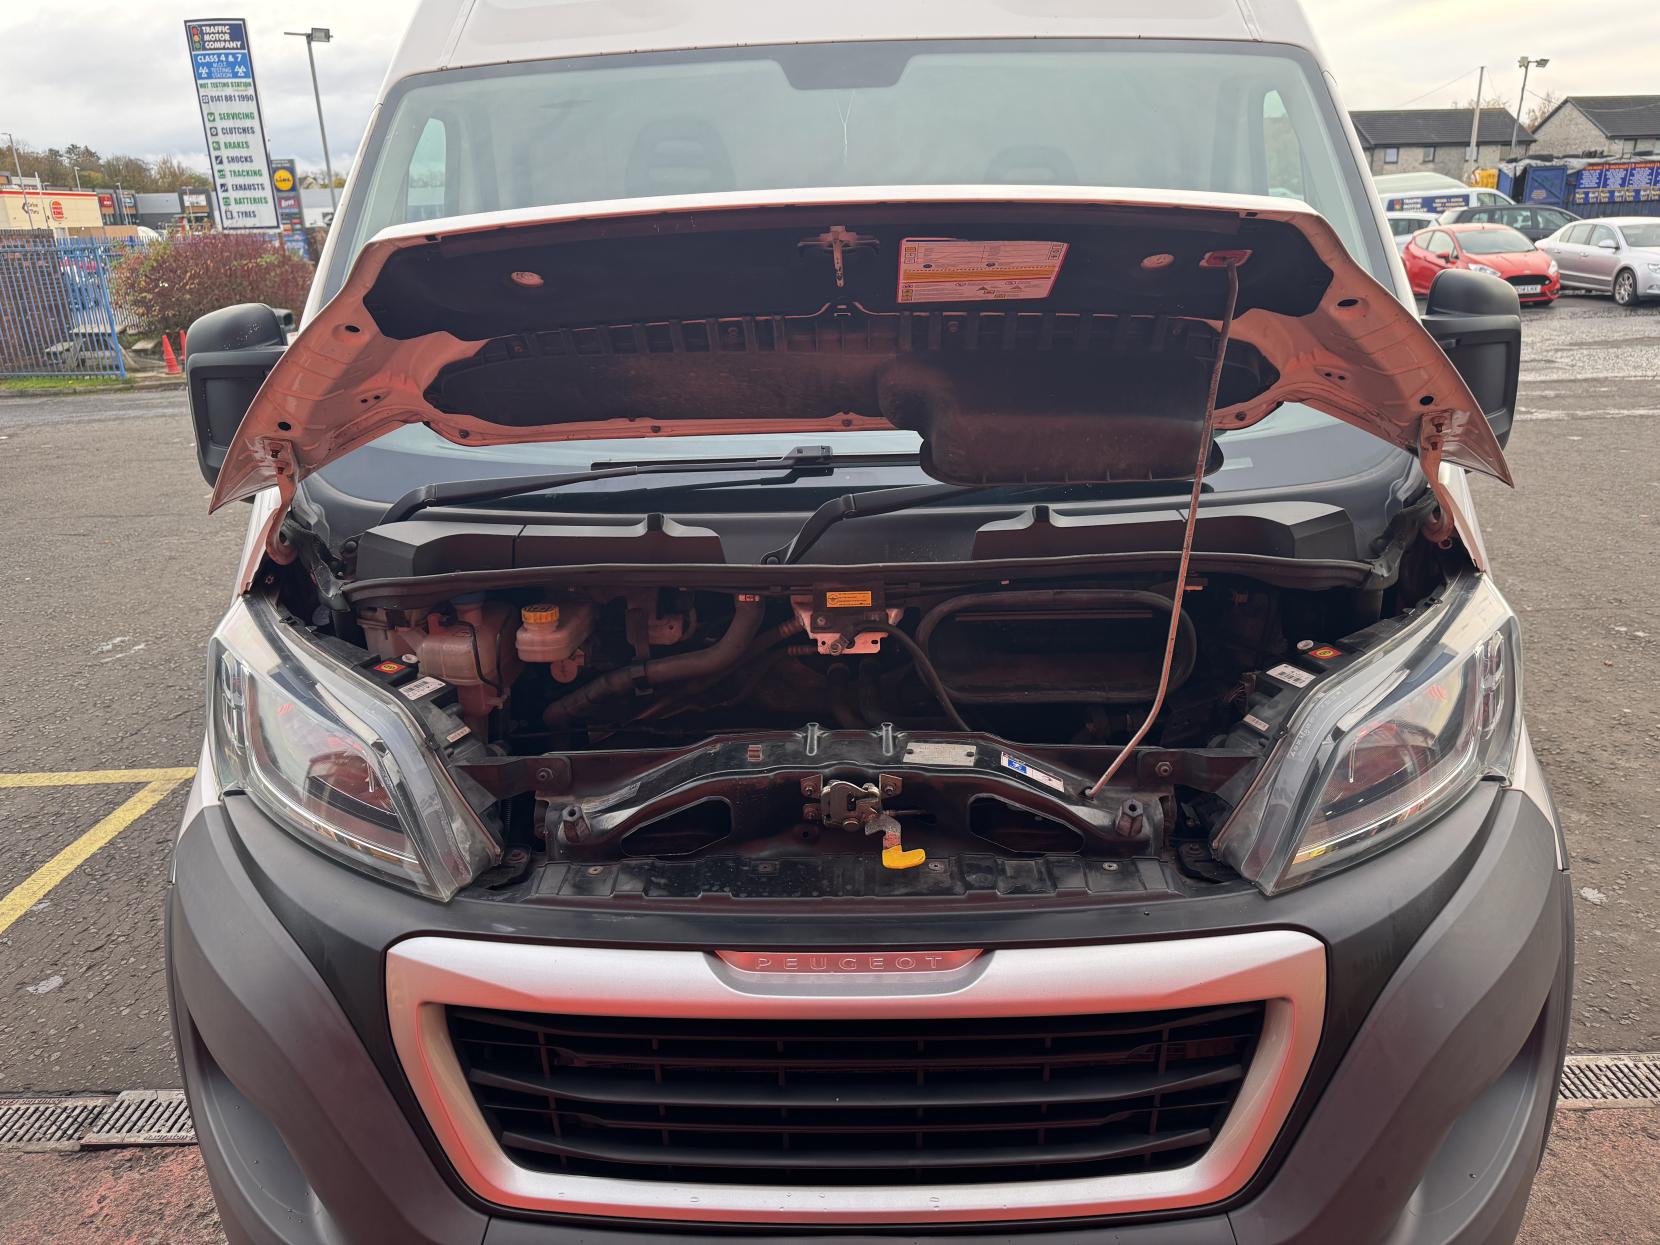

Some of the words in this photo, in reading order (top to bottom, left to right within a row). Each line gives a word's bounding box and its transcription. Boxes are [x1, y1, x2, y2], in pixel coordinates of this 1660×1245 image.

[202, 25, 230, 33] TRAFFIC
[203, 33, 230, 41] MOTOR
[204, 41, 241, 49] COMPANY
[197, 54, 218, 63] CLASS
[228, 54, 234, 62] &
[235, 54, 242, 62] 7
[209, 94, 224, 103] 0141
[218, 112, 255, 121] SERVICING
[221, 126, 255, 135] CLUTCHES
[224, 141, 250, 149] BRAKES
[226, 155, 254, 164] SHOCKS
[229, 169, 263, 178] TRACKING
[231, 183, 265, 191] EXHAUSTS
[233, 197, 268, 205] BATTERIES
[237, 210, 257, 218] TYRES
[755, 957, 943, 970] PEUGEOT
